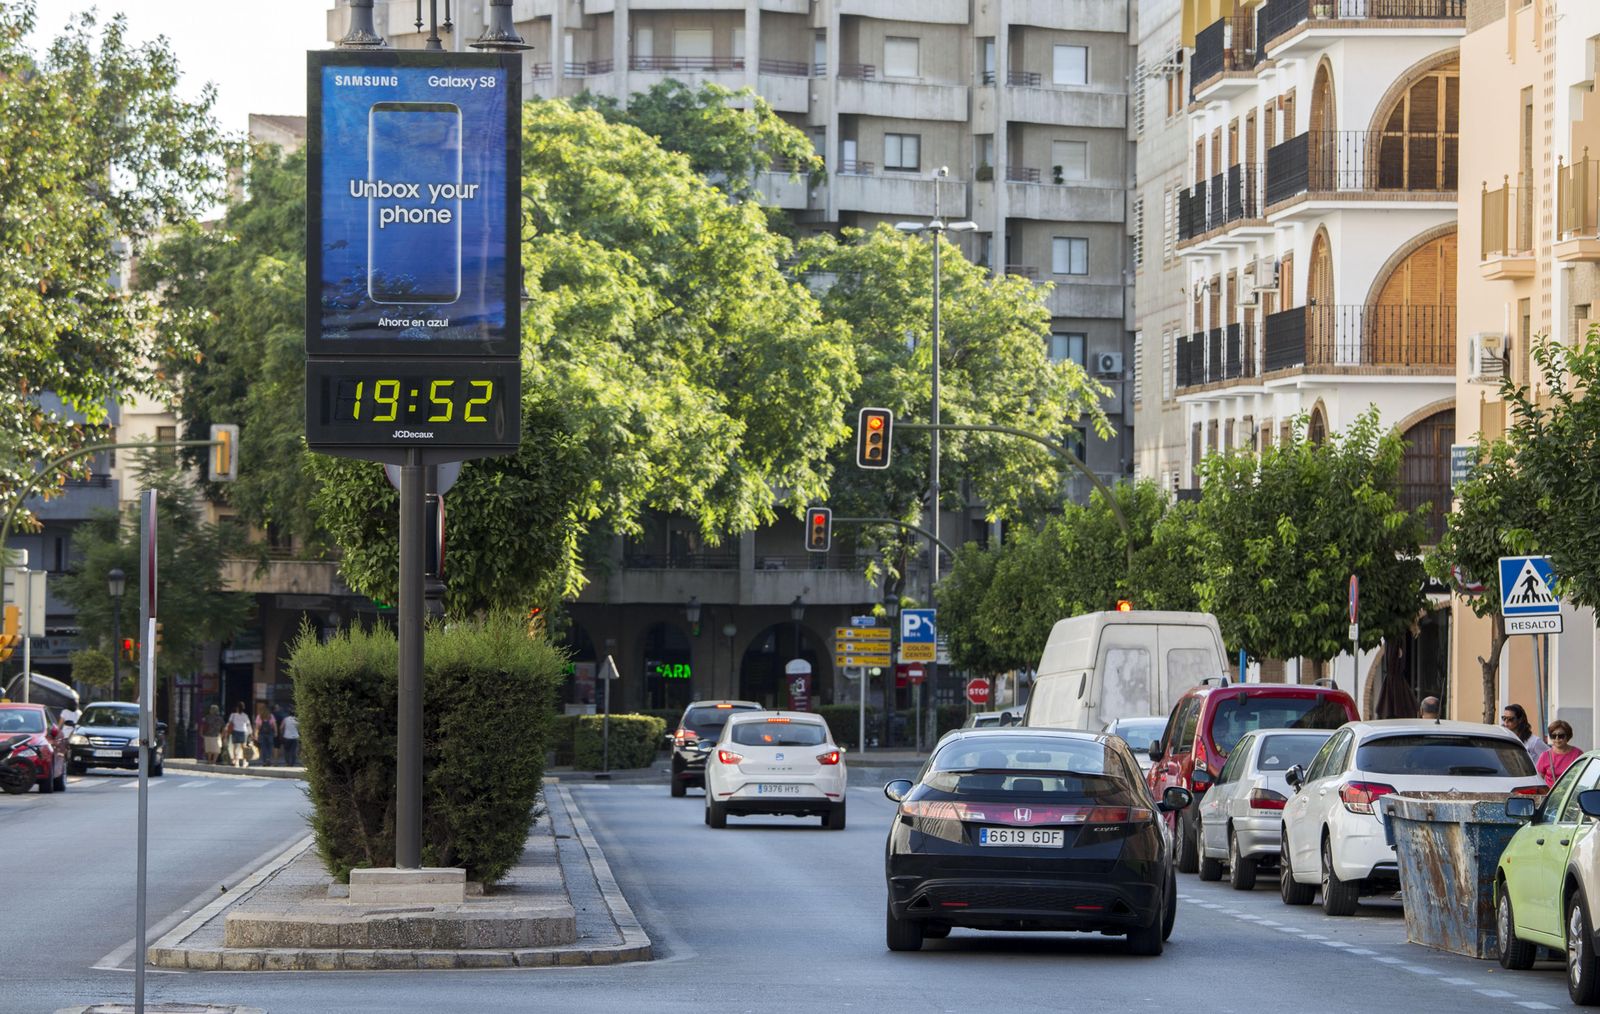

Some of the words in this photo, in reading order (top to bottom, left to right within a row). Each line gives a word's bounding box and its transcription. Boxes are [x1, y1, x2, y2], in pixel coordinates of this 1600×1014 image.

[335, 76, 398, 87] SAMSUNG
[428, 76, 477, 90] Galaxy
[479, 76, 496, 88] S8
[349, 180, 419, 199] Unbox
[428, 182, 479, 204] your
[379, 205, 452, 228] phone
[378, 318, 409, 327] Ahora
[411, 319, 425, 327] en
[427, 318, 449, 327] azul
[352, 380, 494, 422] 19:52
[393, 430, 433, 439] JCDecaux
[903, 614, 921, 637] P
[1511, 620, 1556, 631] RESALTO
[969, 688, 989, 696] STOP
[763, 784, 783, 793] 9376
[990, 830, 1025, 843] 6619
[1032, 831, 1061, 844] GDF
